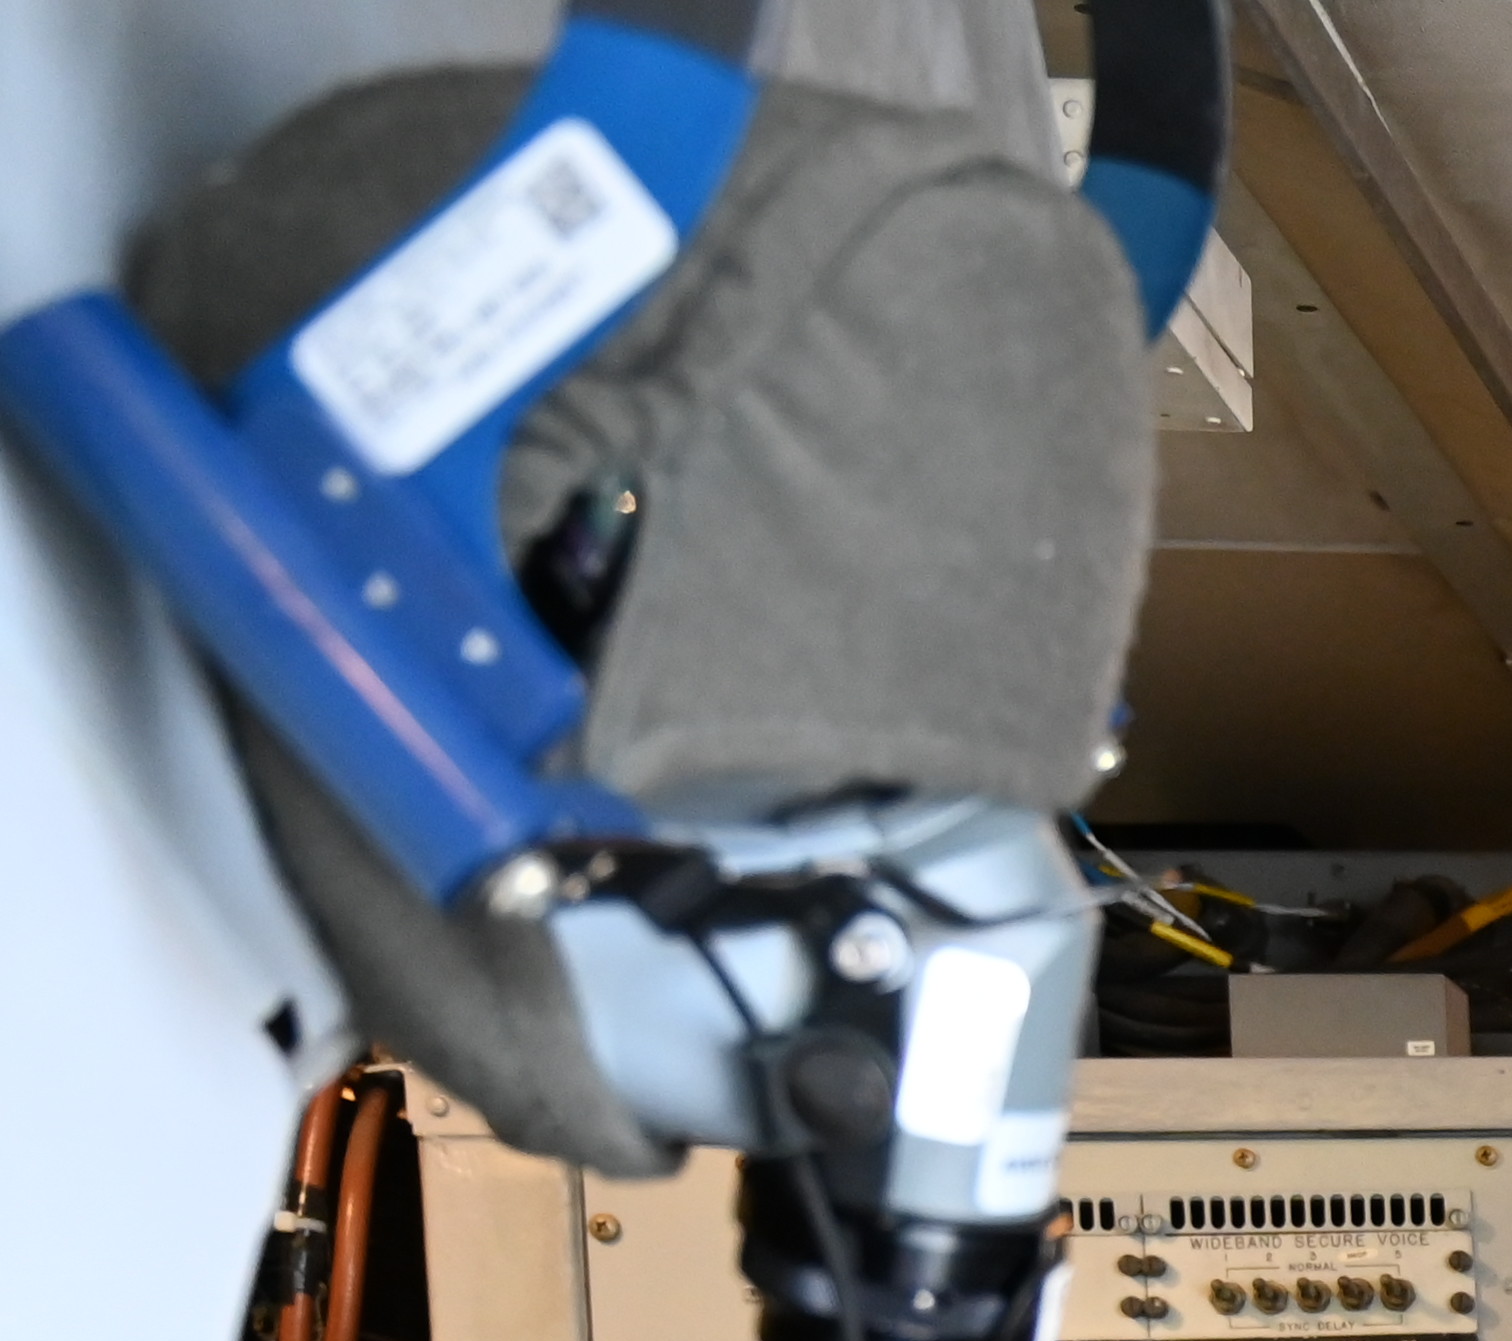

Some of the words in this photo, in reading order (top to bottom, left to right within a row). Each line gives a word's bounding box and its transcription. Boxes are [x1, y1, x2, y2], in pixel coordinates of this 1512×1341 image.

[1190, 1235, 1282, 1250] WIDEBAND
[1295, 1234, 1366, 1248] SECURE
[1378, 1232, 1430, 1247] VOICE
[1288, 1262, 1338, 1272] NORMAL
[1279, 1321, 1310, 1332] SYNC
[1317, 1320, 1356, 1331] DELAY
